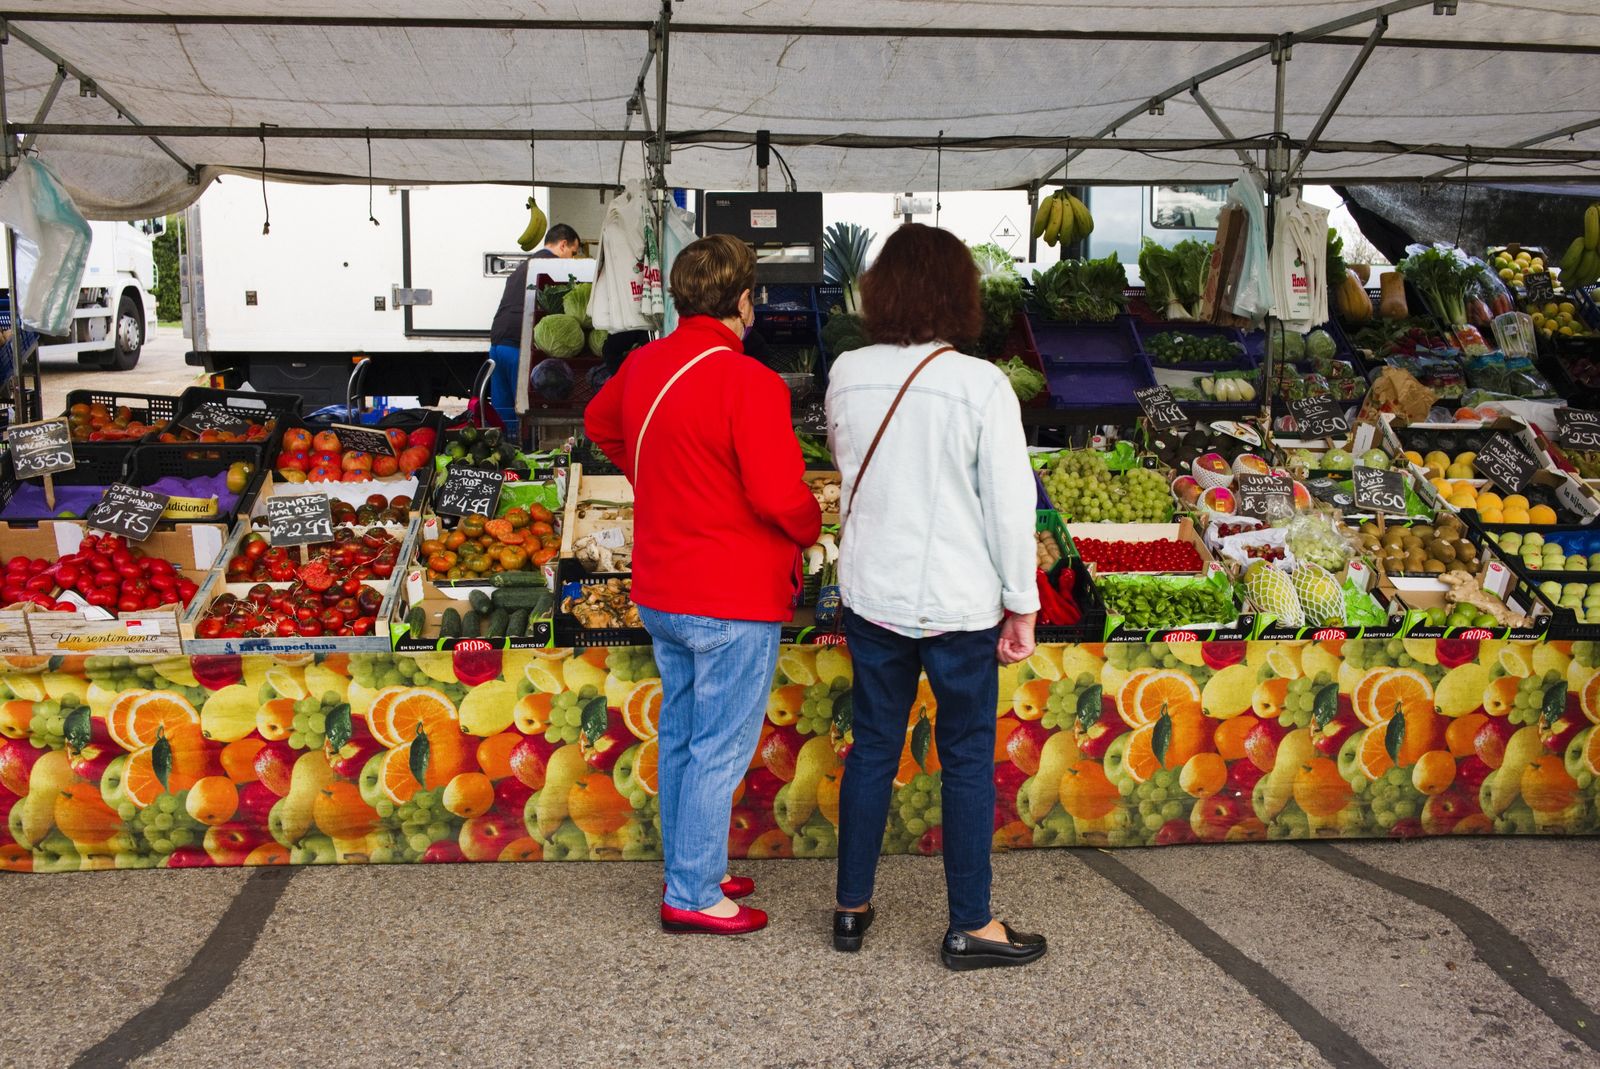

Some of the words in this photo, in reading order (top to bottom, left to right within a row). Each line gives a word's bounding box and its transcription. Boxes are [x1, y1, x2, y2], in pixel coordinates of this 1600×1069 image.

[1003, 228, 1010, 236] M
[450, 468, 503, 481] AUTENTICO
[1248, 475, 1284, 486] UVAS
[459, 477, 483, 488] RAF
[266, 494, 327, 510] TOMATES
[294, 504, 325, 514] AZUL
[86, 633, 159, 644] sentimiento
[815, 634, 848, 646] TROPS
[1164, 631, 1197, 644] TROPS
[1314, 629, 1346, 641] TROPS
[1460, 629, 1492, 640] TROPS
[255, 641, 338, 653] Campechana
[455, 640, 492, 652] TROPS
